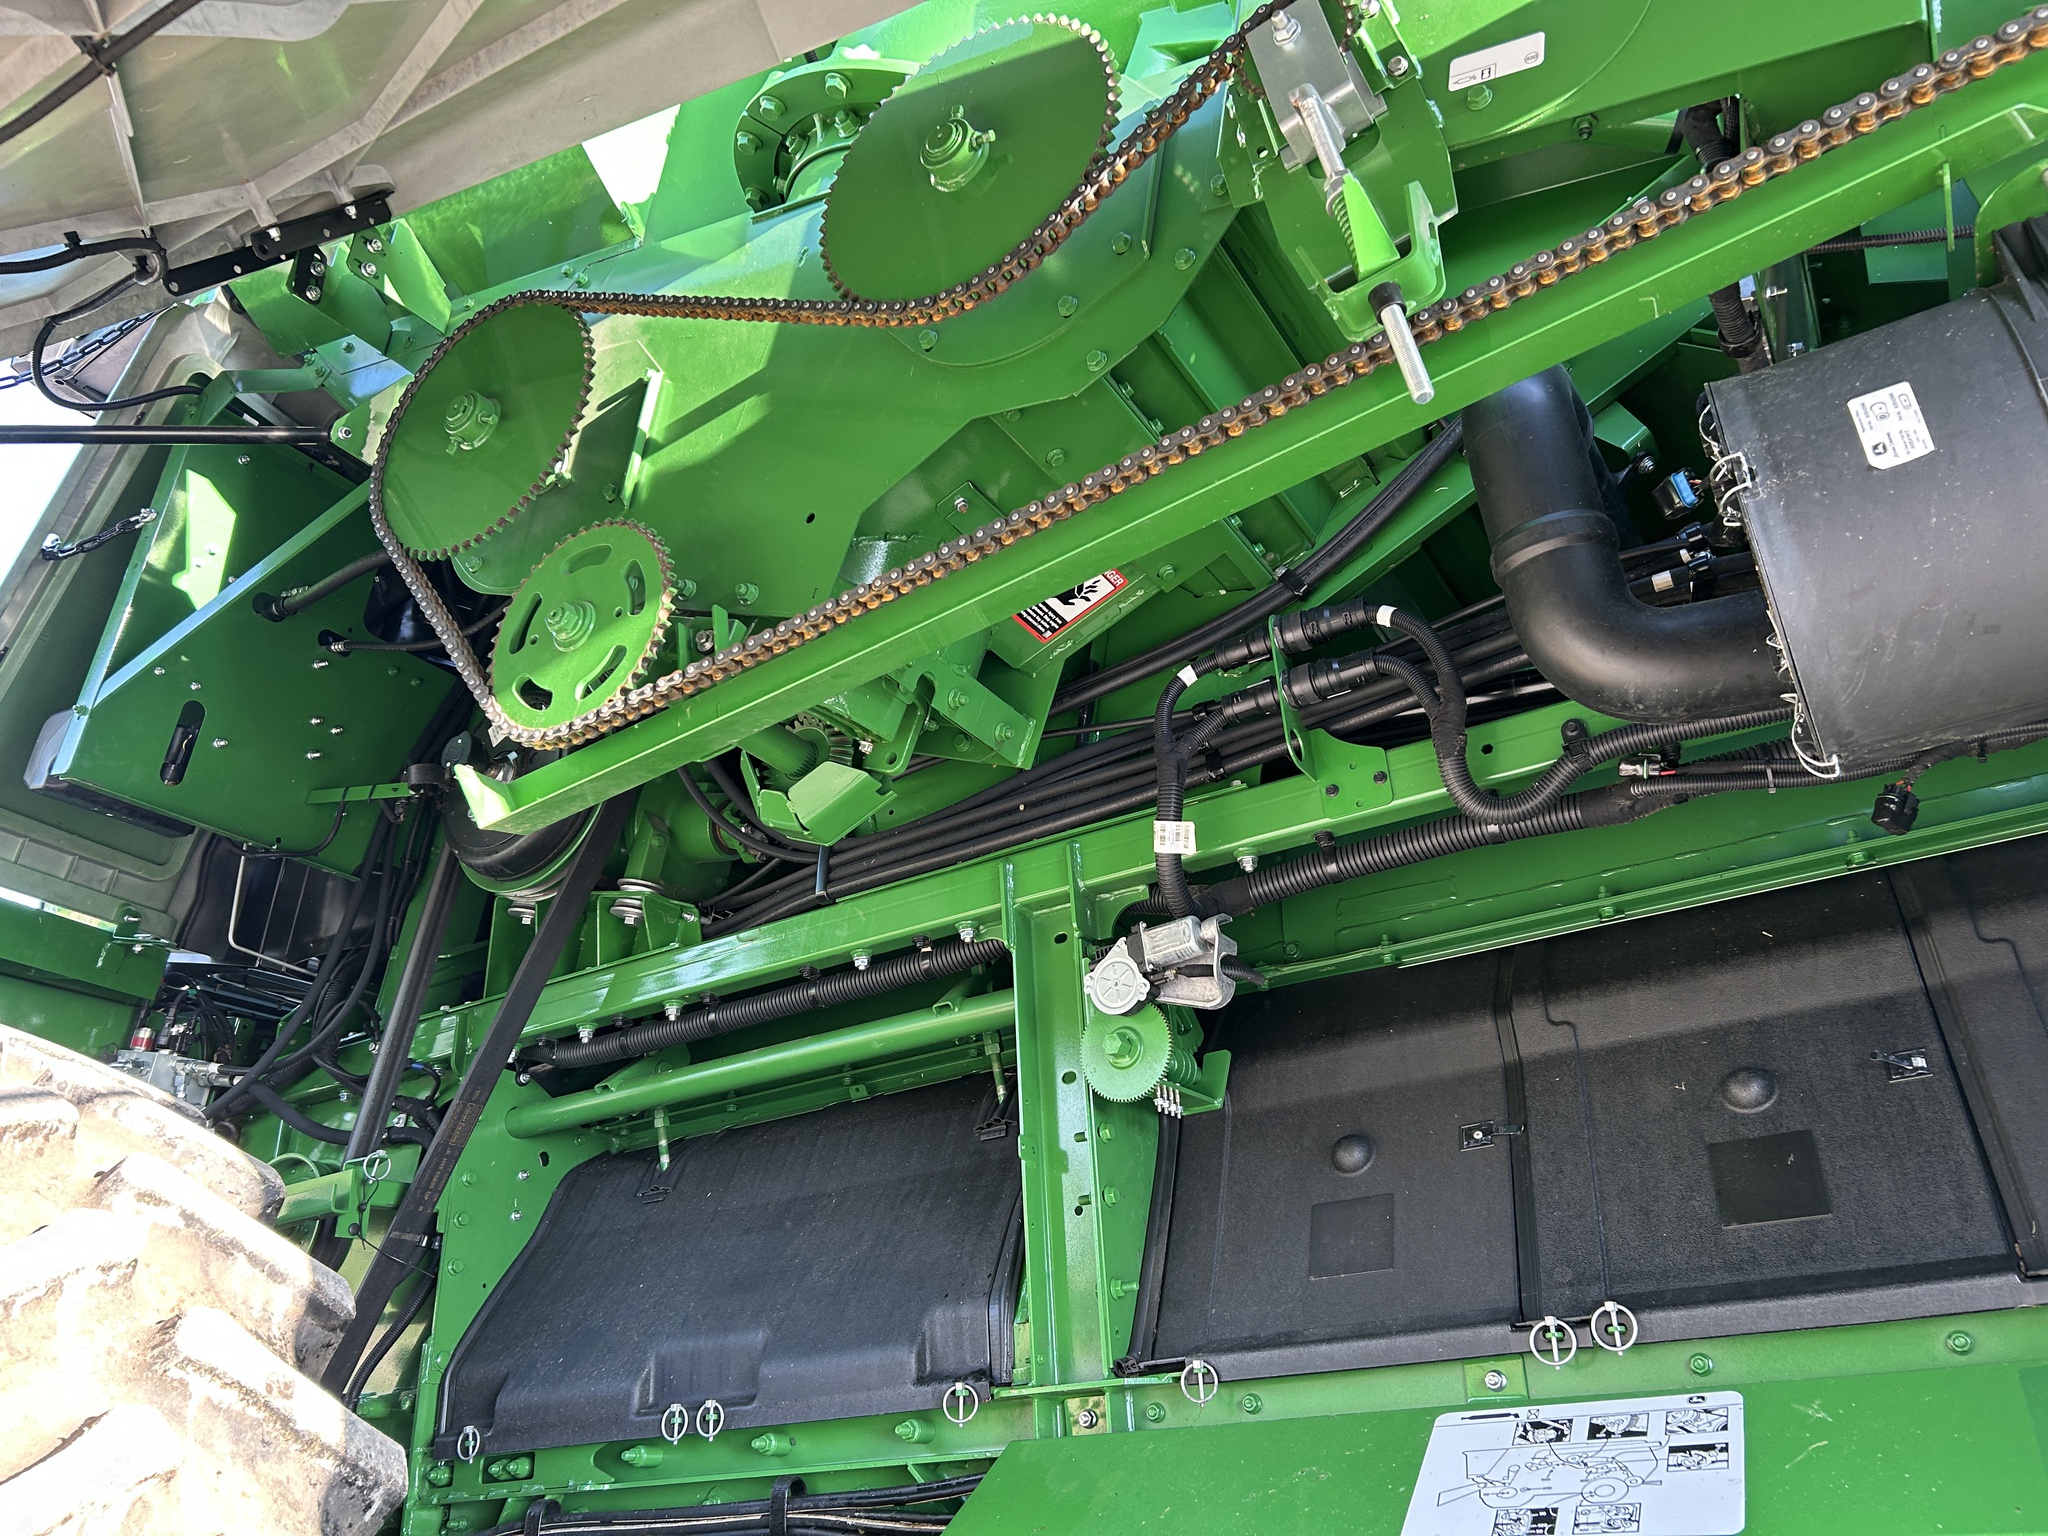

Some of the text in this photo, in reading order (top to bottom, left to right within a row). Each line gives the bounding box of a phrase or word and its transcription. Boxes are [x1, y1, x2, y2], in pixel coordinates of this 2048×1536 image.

[1886, 432, 1894, 446] DEERE
[1048, 611, 1056, 619] injury
[1041, 620, 1050, 628] before
[1050, 620, 1059, 628] engine
[451, 1121, 464, 1144] DEERE
